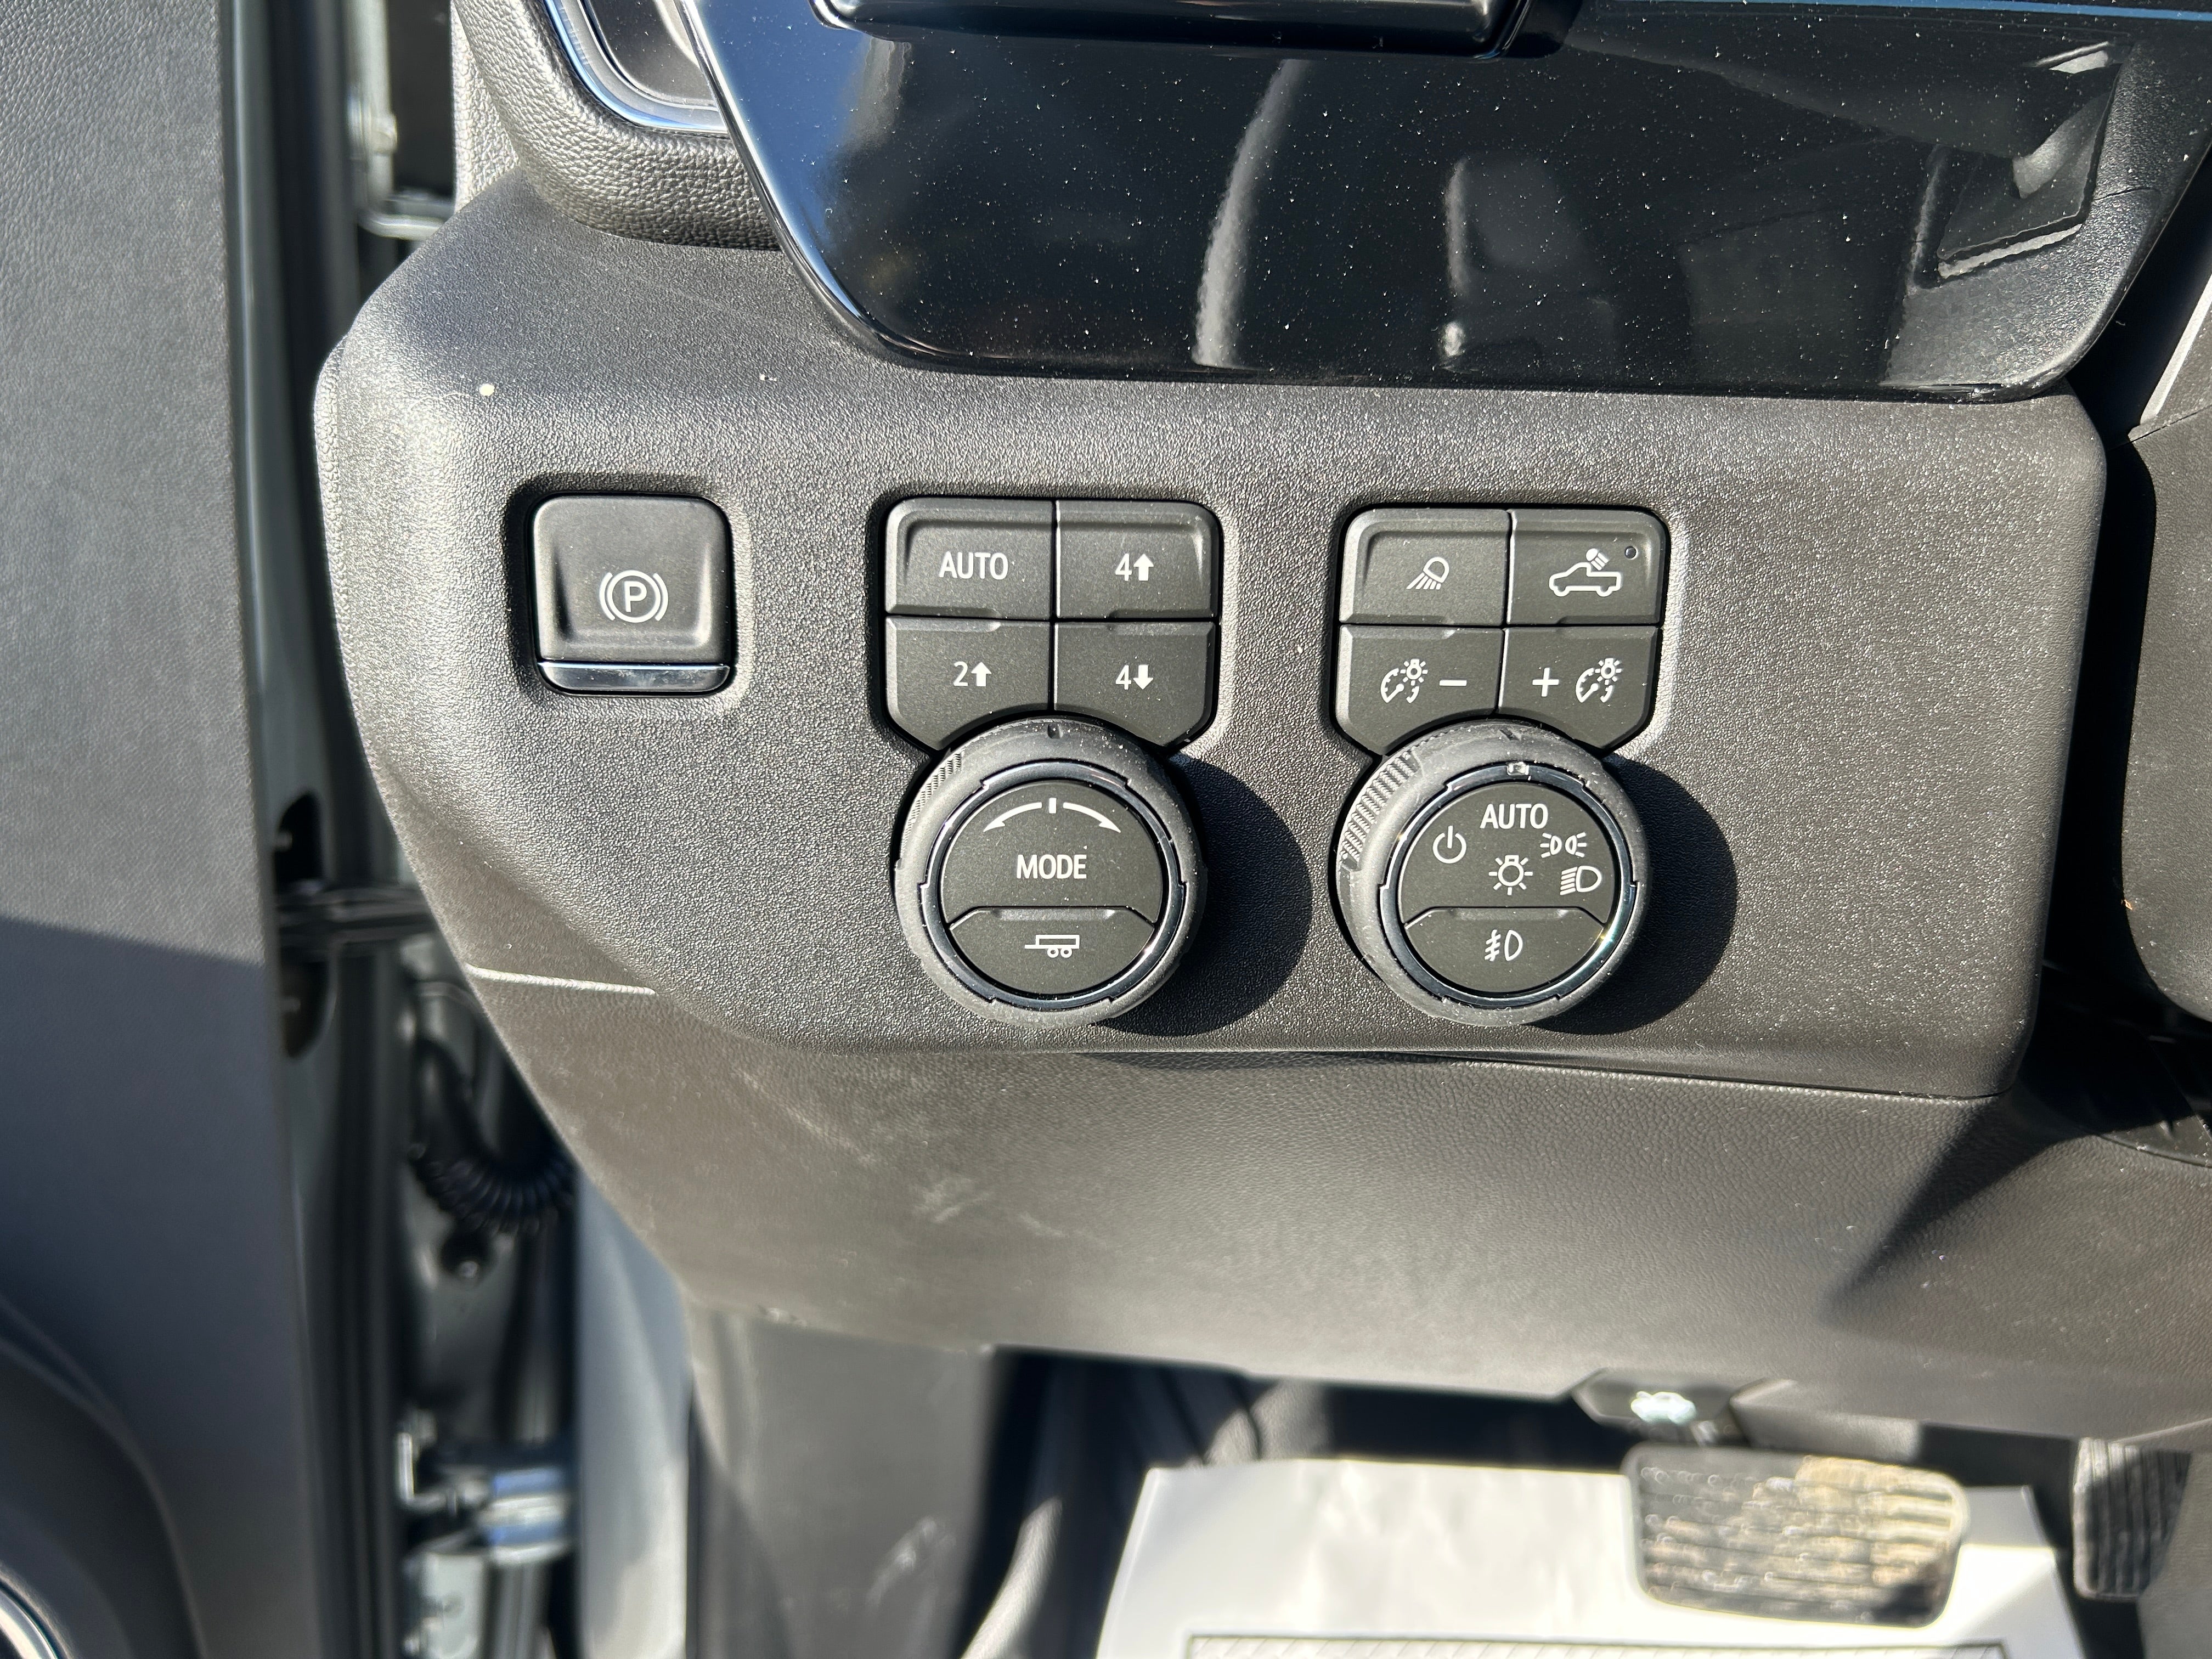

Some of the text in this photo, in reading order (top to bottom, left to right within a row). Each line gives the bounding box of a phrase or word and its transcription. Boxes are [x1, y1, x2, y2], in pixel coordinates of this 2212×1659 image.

[939, 551, 1009, 580] AUTO
[1115, 553, 1133, 581] 4
[624, 580, 648, 613] P
[953, 661, 969, 687] 2
[1115, 664, 1132, 690] 4
[1480, 803, 1548, 830] AUTO
[1016, 854, 1087, 879] MODE
